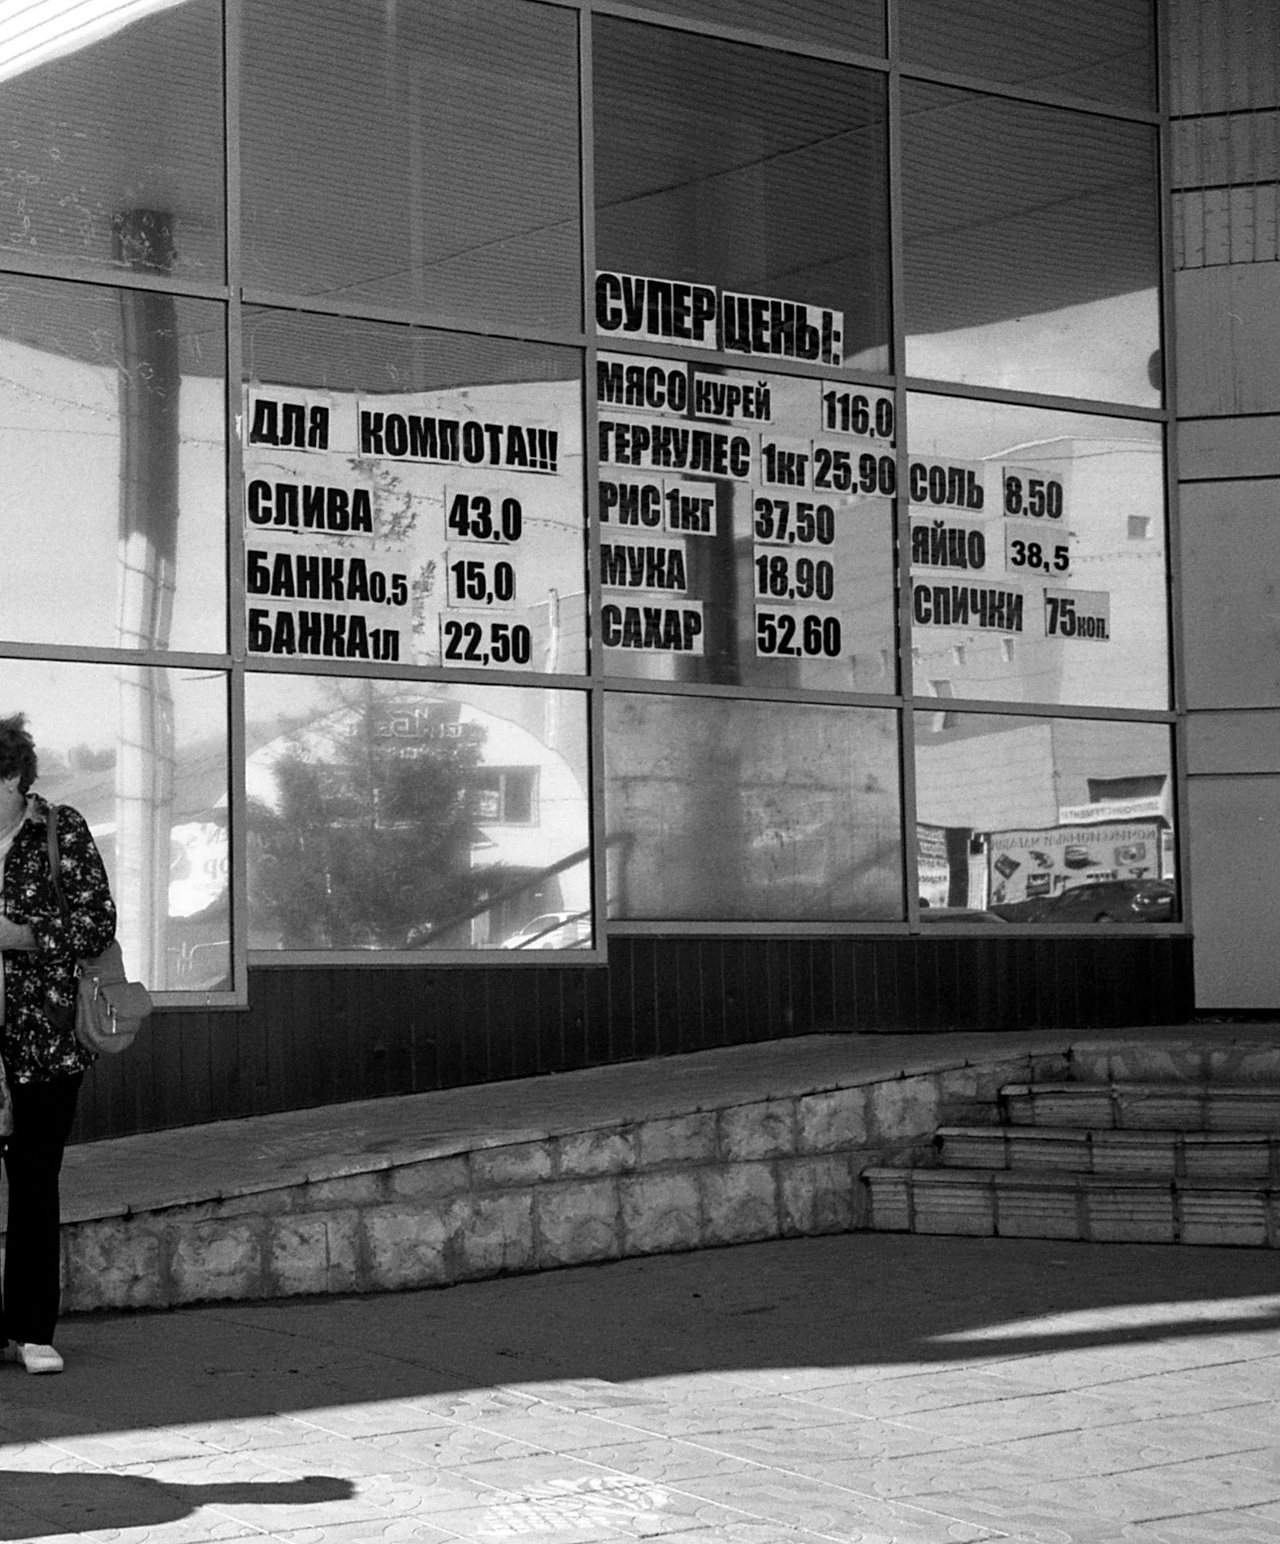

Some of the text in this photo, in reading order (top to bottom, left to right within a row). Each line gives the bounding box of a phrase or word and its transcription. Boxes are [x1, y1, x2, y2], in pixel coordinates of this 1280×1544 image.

[595, 273, 716, 341] СУПЕР
[597, 361, 687, 412] МЯСО
[695, 381, 771, 421] КУРЕЙ
[250, 399, 558, 472] ДЛЯ КОМПОТА!!!
[598, 420, 751, 477] ГЕРКУЛЕС
[762, 443, 809, 487] 1кг
[247, 479, 373, 533] СЛИВА
[599, 481, 661, 528] РИС
[665, 488, 714, 532] 1кг
[910, 463, 984, 510] СОЛЬ
[600, 543, 686, 590] МУКА
[912, 519, 1069, 573] ЯЙЦО 38,5
[451, 560, 513, 605] 15,0
[914, 584, 1023, 632] СПИЧКИ
[444, 621, 530, 666] 22,50
[601, 604, 701, 651] САХАР
